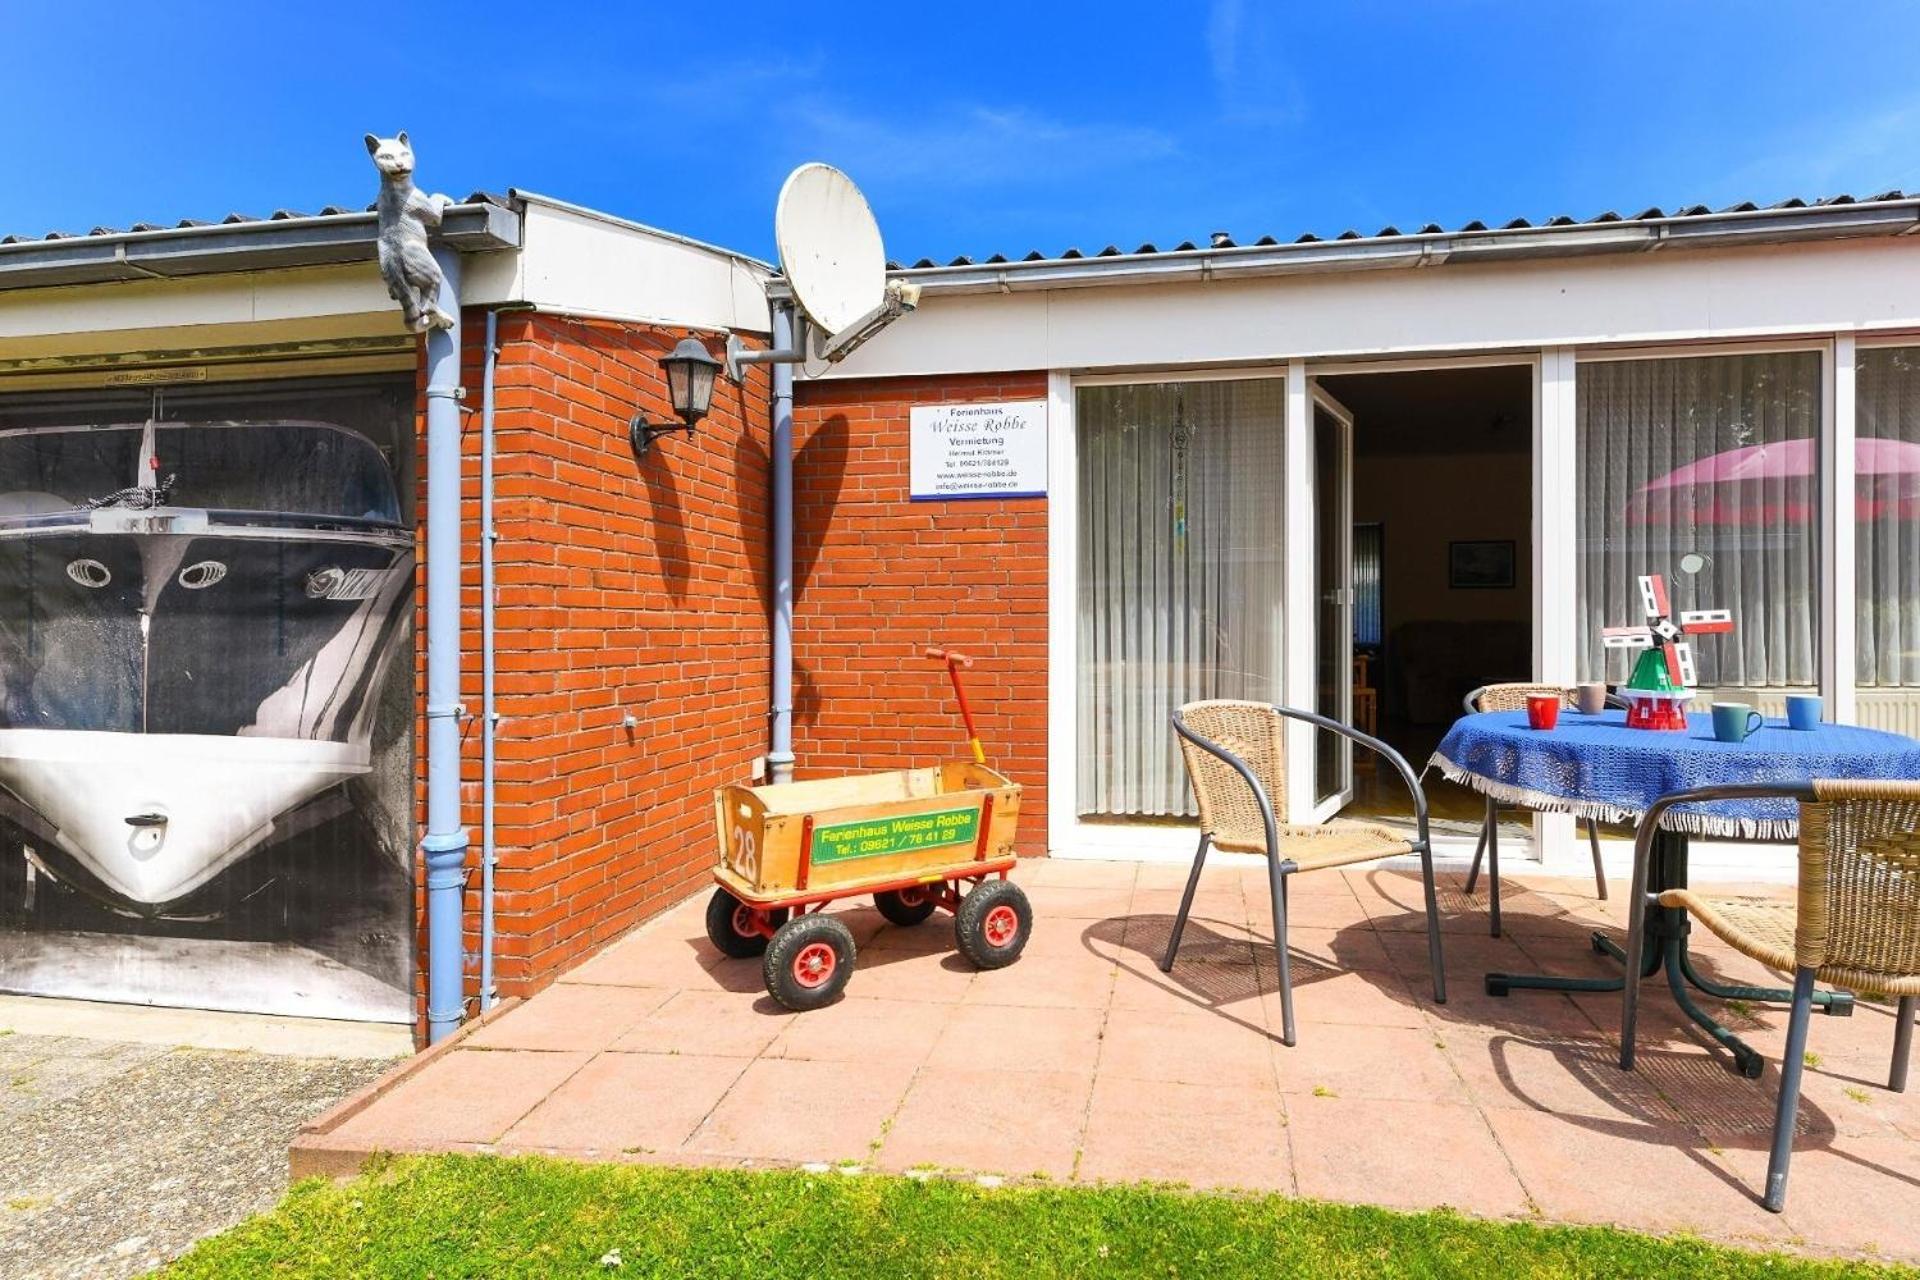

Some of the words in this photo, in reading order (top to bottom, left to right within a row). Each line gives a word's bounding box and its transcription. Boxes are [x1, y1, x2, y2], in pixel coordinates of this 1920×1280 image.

[950, 407, 1003, 416] Ferienhaus
[930, 418, 978, 433] Weisse
[985, 414, 1028, 432] Robbe
[949, 437, 1005, 446] Vermietung
[821, 826, 888, 843] Ferienhaus
[892, 819, 934, 833] Weisse
[936, 813, 971, 827] Robbe
[860, 838, 896, 852] 09621
[926, 831, 938, 841] 41
[734, 824, 757, 884] 28
